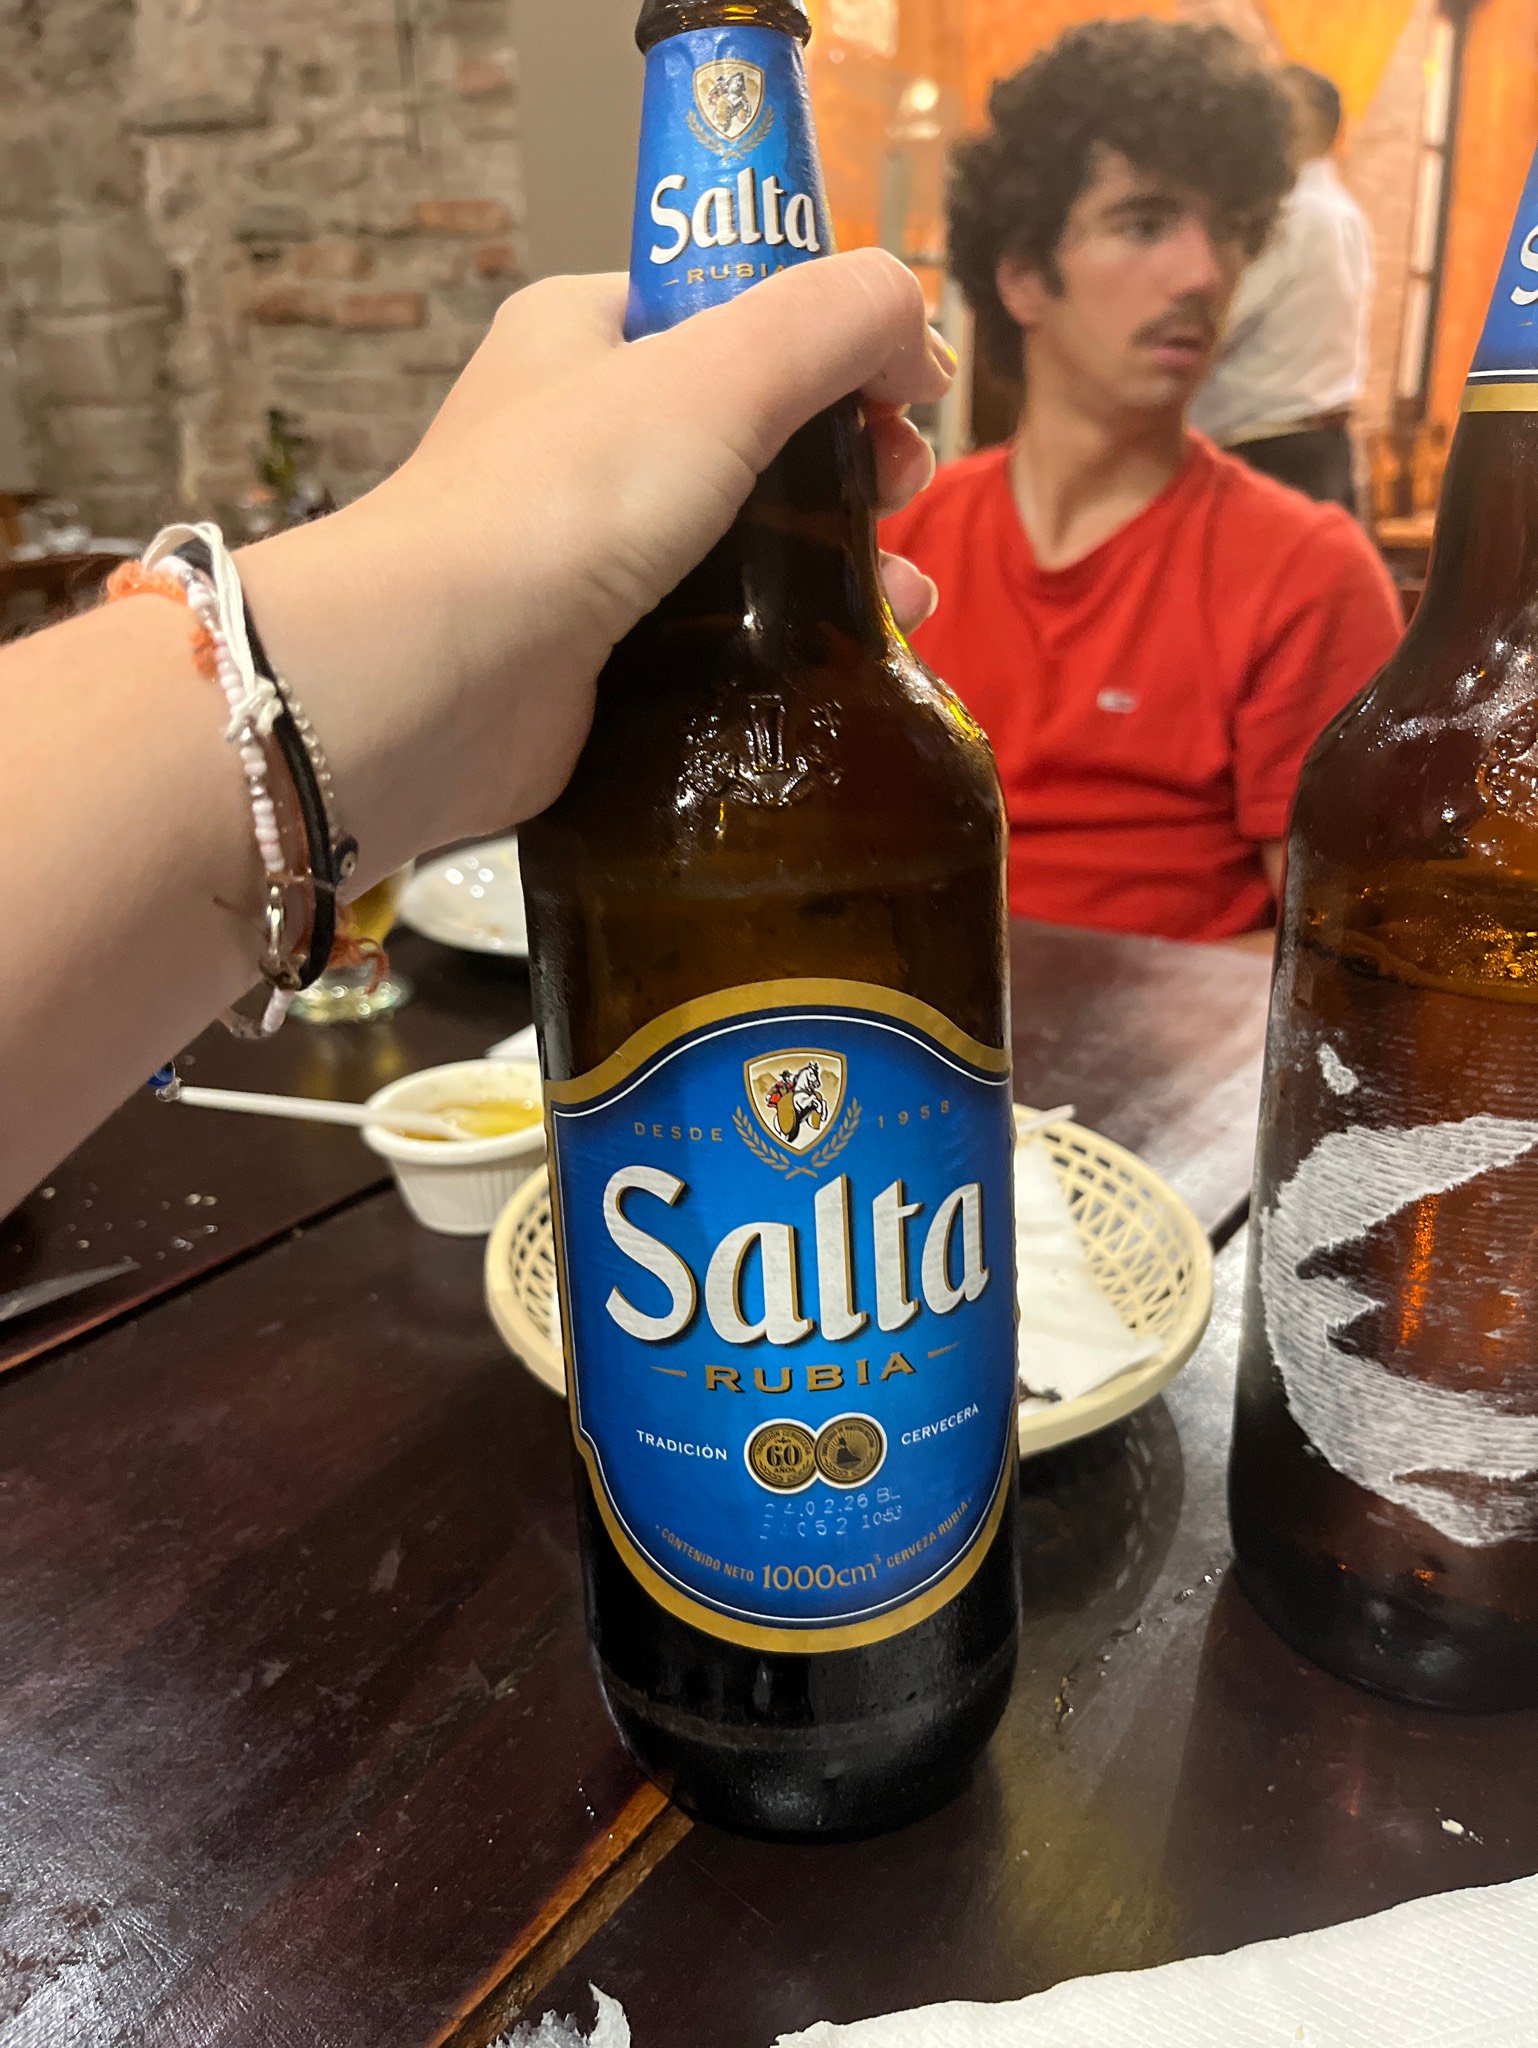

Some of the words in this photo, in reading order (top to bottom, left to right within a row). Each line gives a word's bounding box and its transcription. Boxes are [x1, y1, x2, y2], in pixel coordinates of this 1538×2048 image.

[649, 166, 820, 264] Salta
[634, 1121, 723, 1142] DESDE
[602, 1165, 989, 1346] Salta
[705, 1352, 917, 1393] RUBIA
[636, 1429, 728, 1461] TRADICIÓN
[901, 1402, 979, 1445] CERVECERA
[766, 1445, 803, 1467] 60
[661, 1528, 721, 1571] CONTENIDO
[724, 1563, 755, 1582] NETO
[886, 1532, 937, 1569] CERVEZA
[937, 1501, 968, 1536] RUBIA
